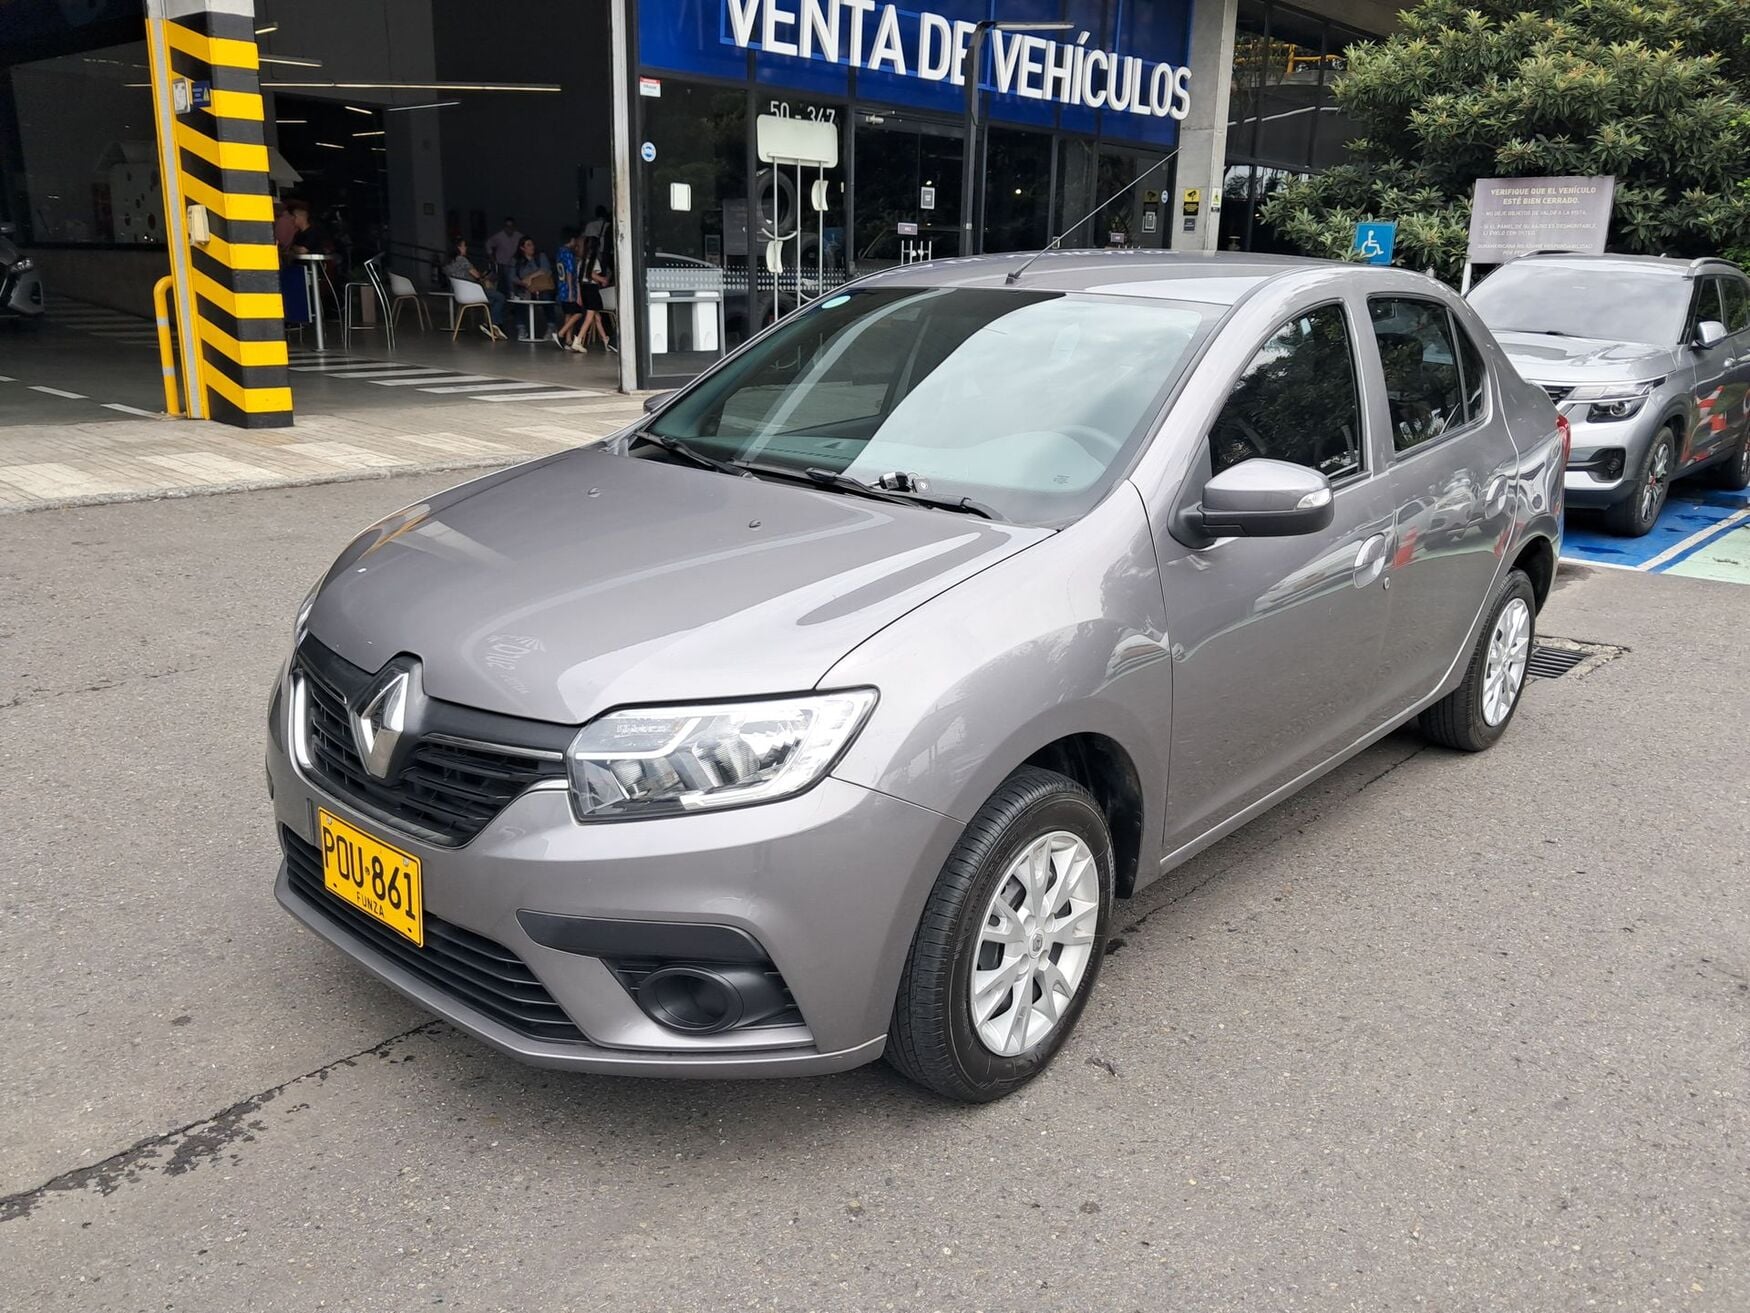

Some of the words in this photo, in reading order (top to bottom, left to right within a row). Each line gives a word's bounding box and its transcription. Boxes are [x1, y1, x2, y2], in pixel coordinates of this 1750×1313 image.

[727, 0, 906, 75] VENTA
[918, 12, 977, 86] DE
[992, 29, 1193, 121] VEHÍCULOS
[1490, 187, 1529, 196] VERIFIQUE
[1530, 187, 1546, 195] QUE
[1548, 187, 1557, 195] EL
[1503, 196, 1522, 205] ESTÉ
[1523, 197, 1541, 205] BIEN
[356, 891, 385, 918] FUNZA
